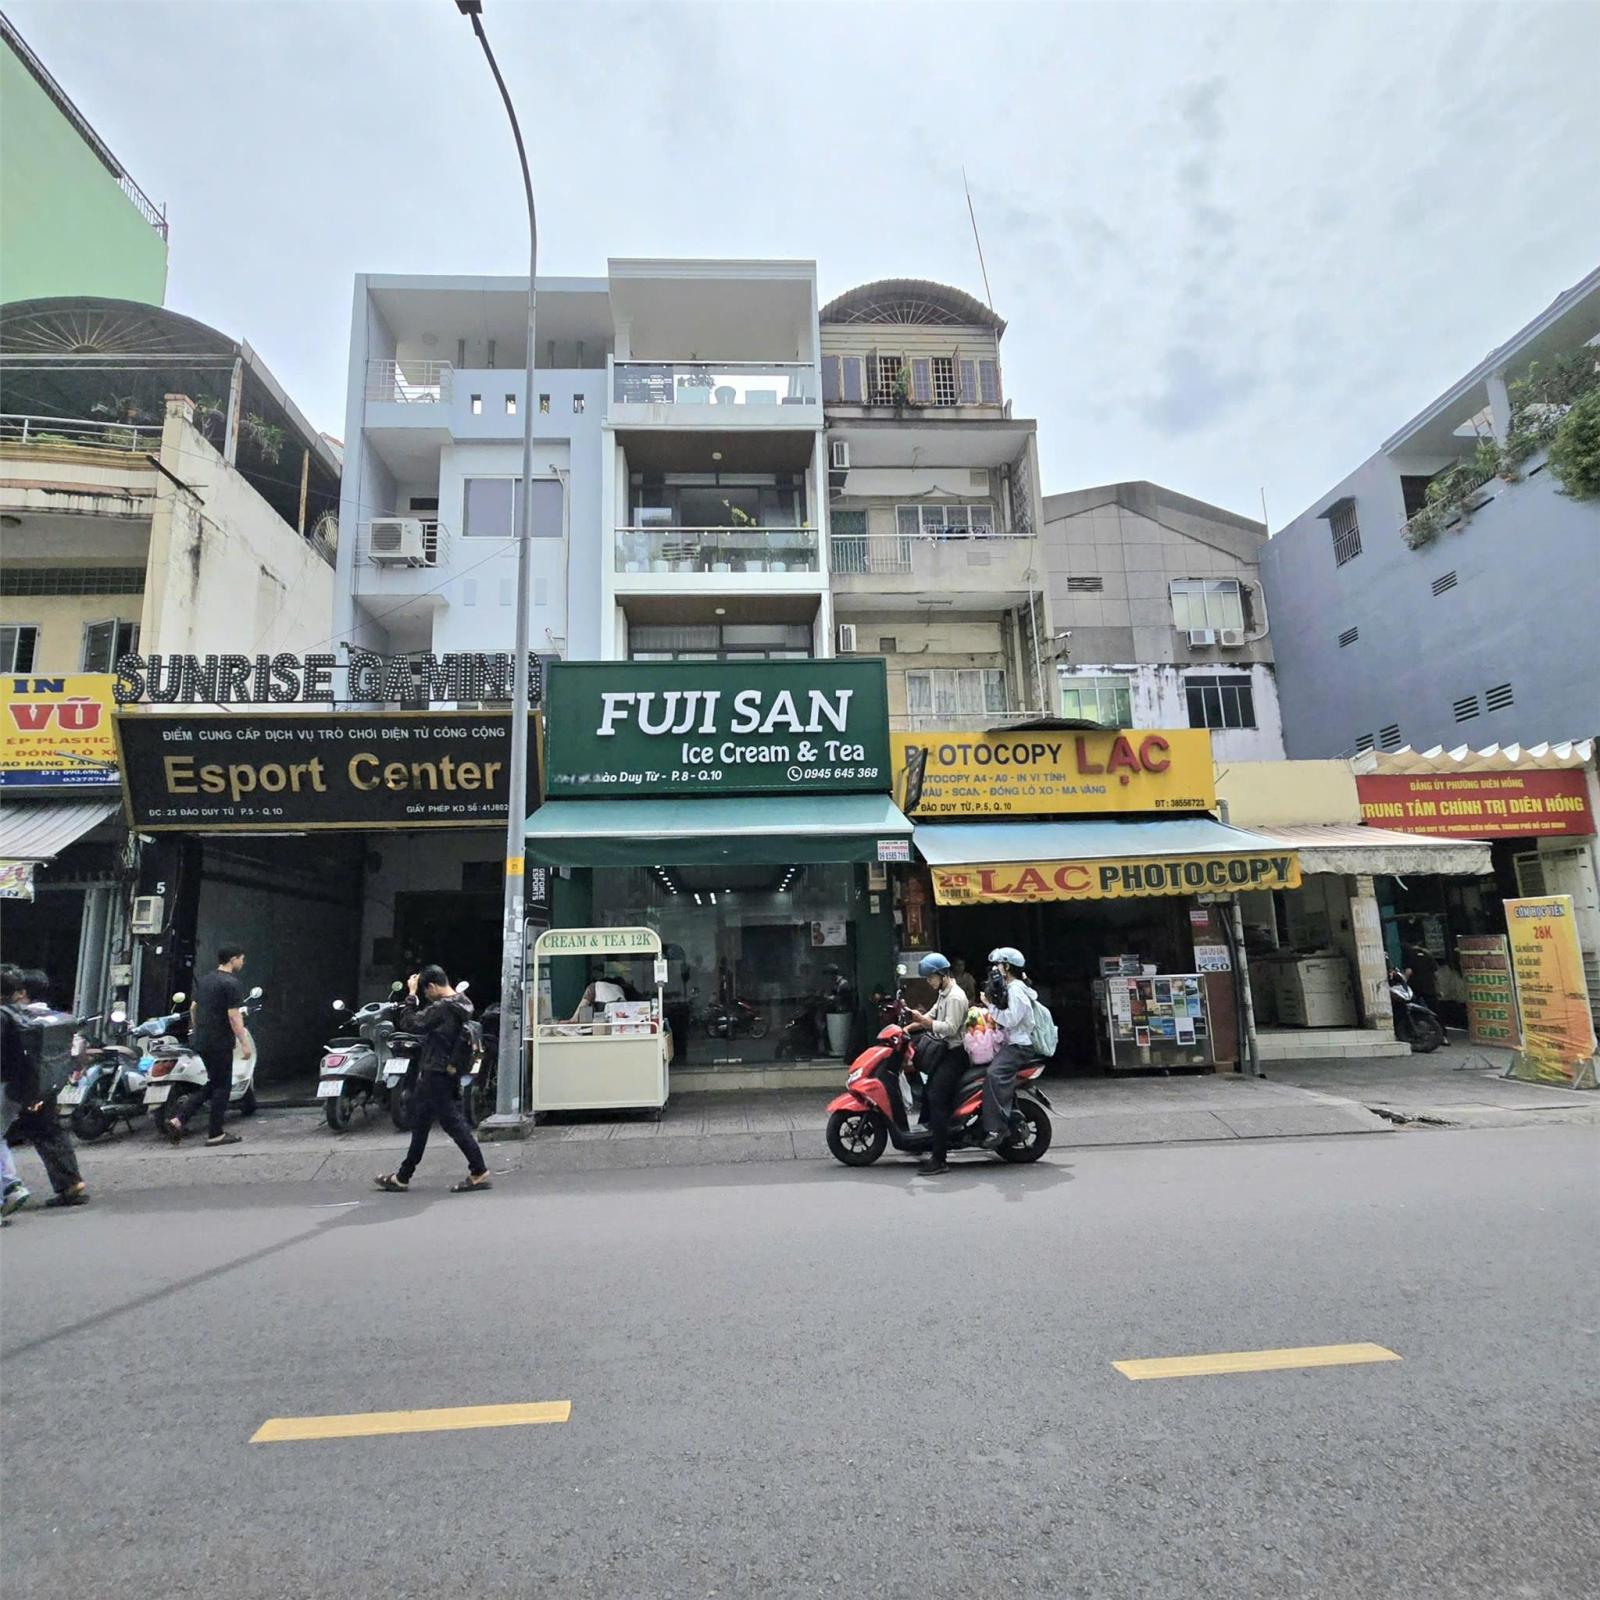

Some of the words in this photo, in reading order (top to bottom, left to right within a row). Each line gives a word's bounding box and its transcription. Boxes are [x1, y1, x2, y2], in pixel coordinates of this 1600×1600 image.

[112, 653, 336, 703] SUNRISE
[349, 652, 542, 702] GAMING
[13, 678, 65, 693] IN
[9, 697, 102, 730] VŨ
[596, 691, 721, 735] FUJI
[730, 689, 853, 734] SAN
[37, 737, 110, 745] PLASTIC
[163, 727, 193, 741] ĐIỂM
[199, 731, 232, 741] CUNG
[236, 727, 261, 741] CẤP
[265, 730, 293, 743] DỊCH
[297, 730, 314, 744] VỤ
[318, 727, 344, 740] TRÒ
[348, 728, 377, 740] CHƠI
[382, 726, 409, 742] ĐIỆN
[413, 725, 430, 739] TỬ
[433, 726, 467, 739] CÔNG
[471, 727, 506, 741] CỘNG
[681, 743, 714, 764] Ice
[720, 742, 790, 764] Cream
[796, 740, 819, 762] &
[825, 740, 865, 762] Tea
[905, 743, 1062, 766] POTOCOPY
[1075, 734, 1172, 786] LẠC
[163, 756, 327, 802] Esport
[348, 752, 502, 791] Center
[619, 771, 643, 785] Duy
[645, 770, 660, 783] Từ
[698, 770, 722, 782] Q.10
[804, 768, 831, 780] 0945
[834, 767, 855, 779] 645
[857, 767, 879, 778] 368
[922, 774, 970, 784] OTOCOPY
[974, 774, 987, 783] A4
[1017, 773, 1026, 782] IN
[167, 808, 178, 817] 25
[201, 808, 219, 816] DUY
[406, 802, 426, 814] GIẤY
[428, 803, 450, 813] PHÉP
[452, 804, 466, 813] KD
[921, 802, 937, 812] ĐÀO
[941, 802, 957, 811] DUY
[1360, 802, 1404, 818] TRUNG
[1406, 799, 1437, 816] TÂM
[1439, 798, 1482, 816] CHÍNH
[1484, 799, 1508, 817] TRỊ
[1510, 795, 1543, 814] DIÊN
[939, 875, 968, 888] 29
[976, 865, 1093, 899] LẠC
[1099, 857, 1291, 892] PHOTOCOPY
[156, 882, 166, 894] 5
[542, 935, 587, 948] CREAM
[590, 935, 599, 947] &
[602, 934, 627, 947] TEA
[630, 933, 652, 946] 12K
[1198, 963, 1230, 972] K50
